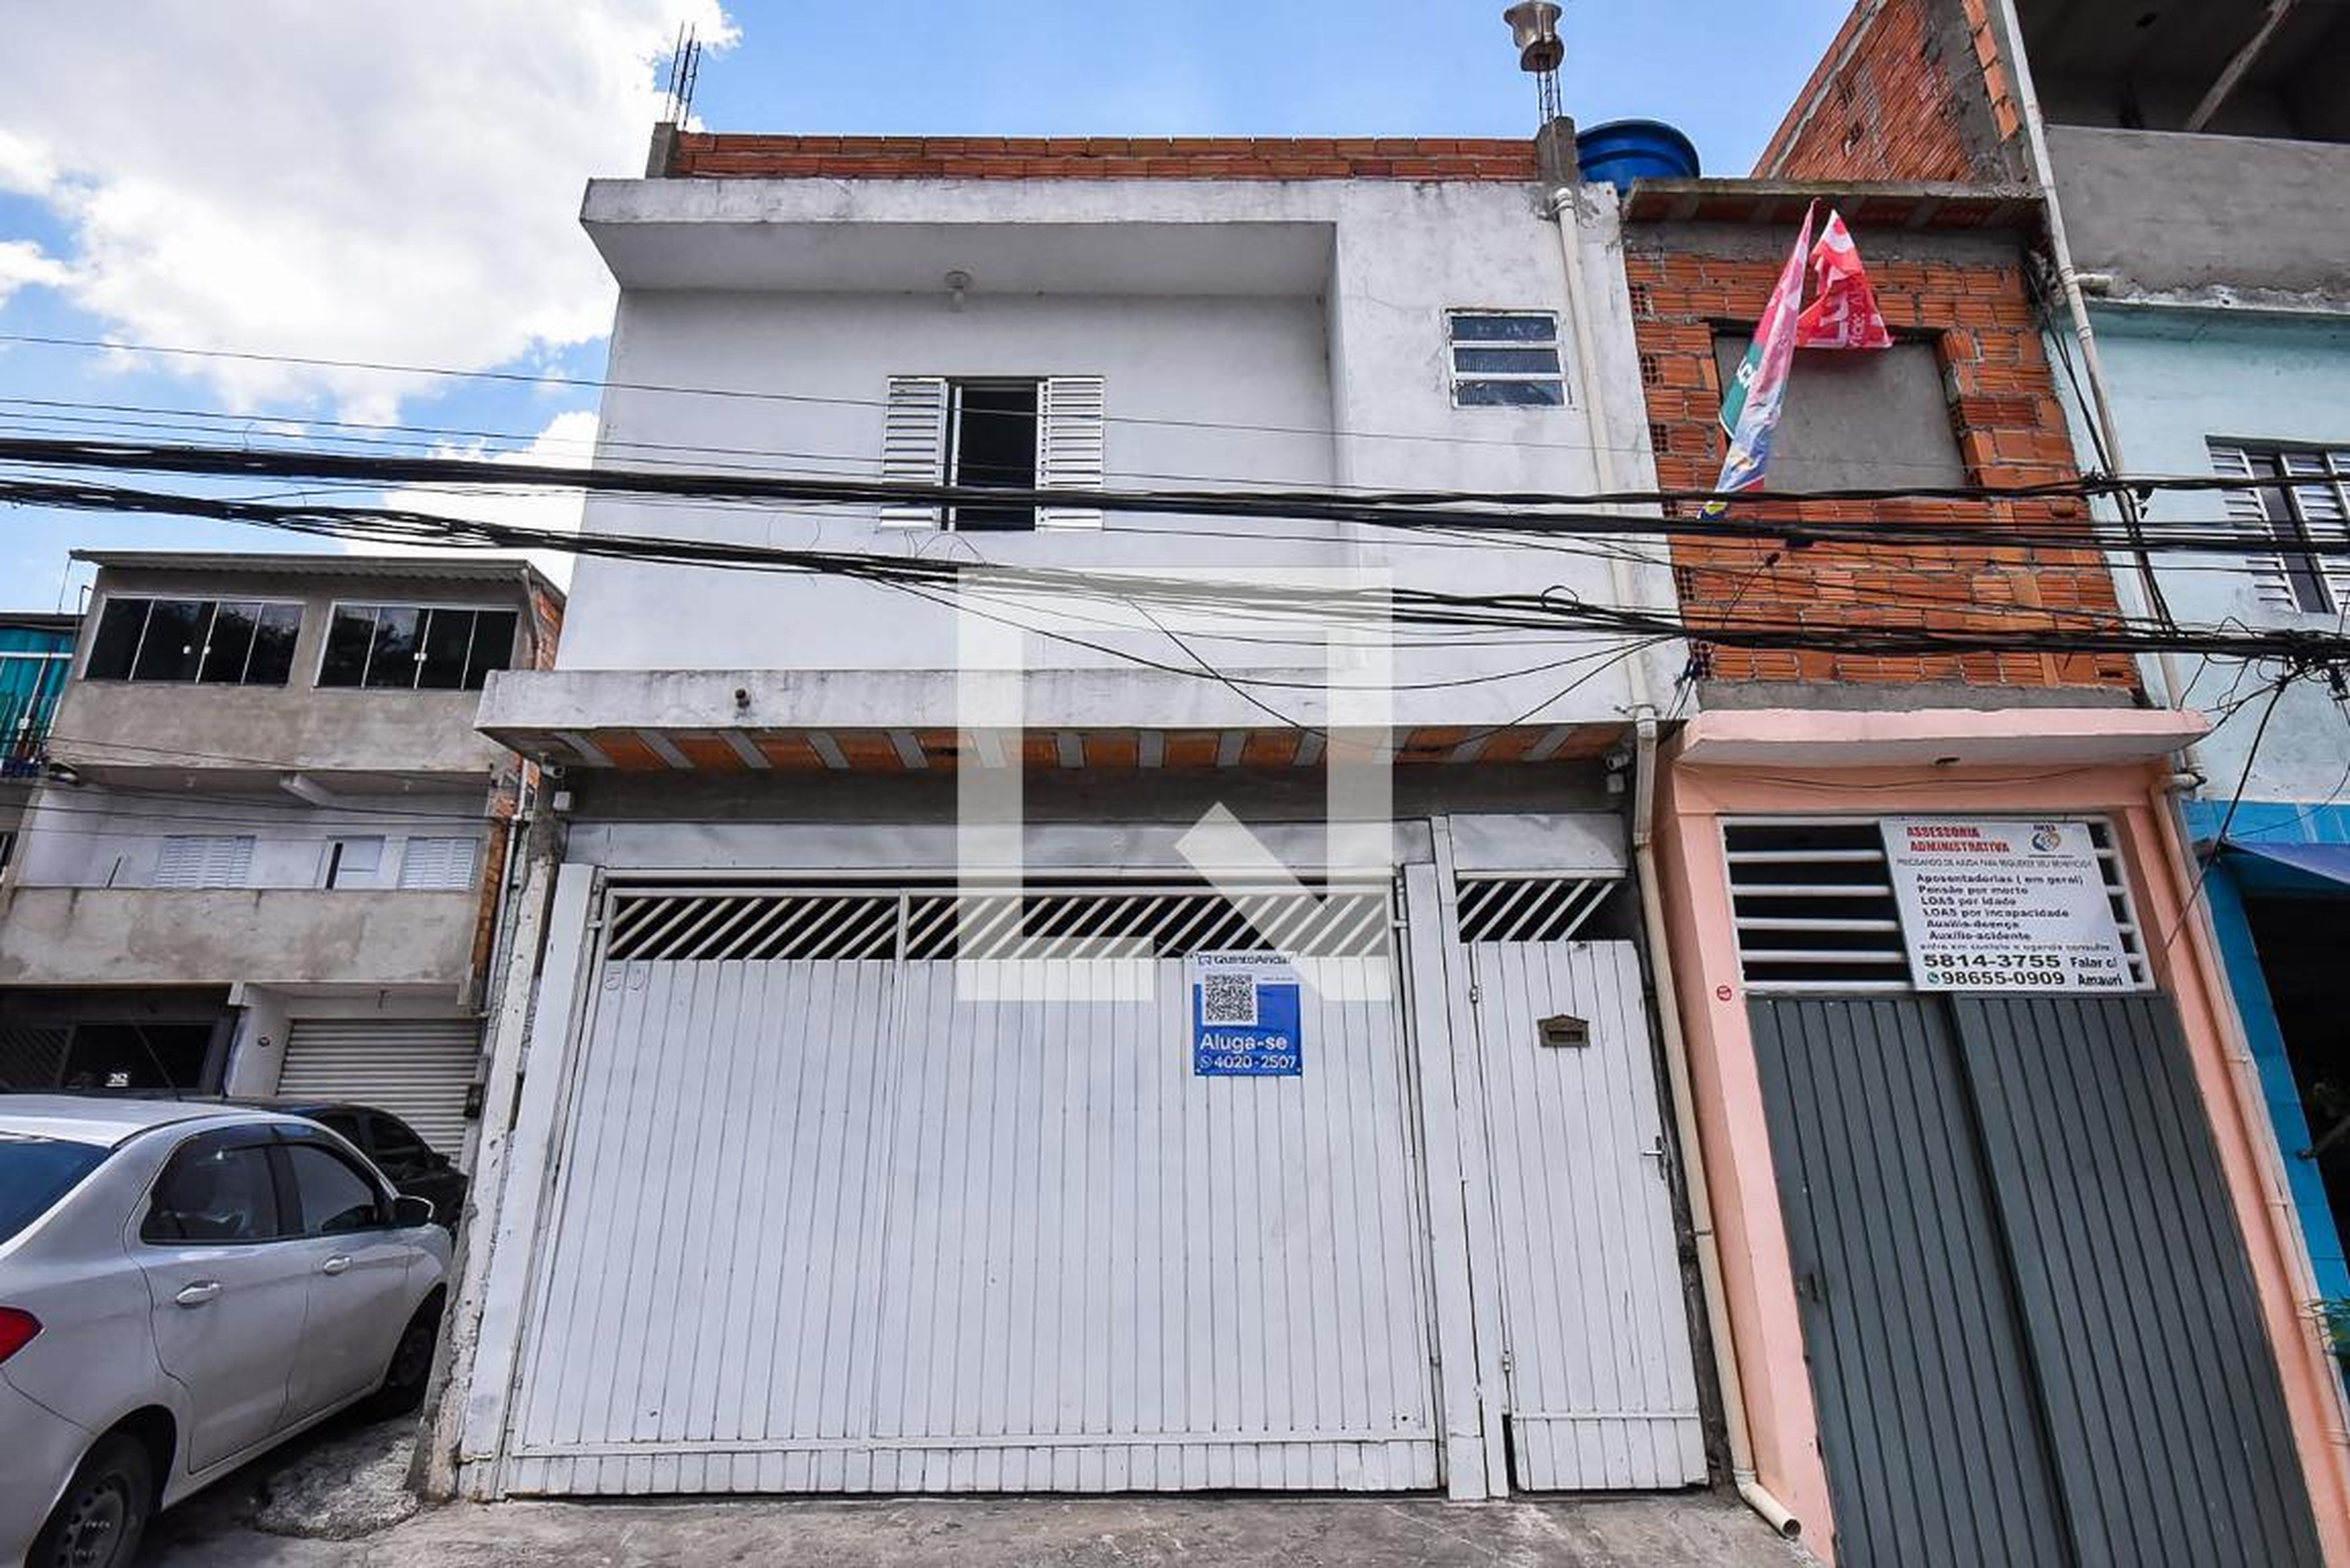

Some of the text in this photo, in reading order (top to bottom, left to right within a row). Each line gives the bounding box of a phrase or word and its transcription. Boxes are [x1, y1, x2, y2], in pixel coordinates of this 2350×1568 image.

[1958, 897, 1978, 906] por
[1961, 909, 1981, 918] por
[1924, 954, 2061, 968] 5814-3755
[2070, 957, 2102, 968] Falar
[1941, 971, 2122, 986] 98655-0909 Amauri
[1199, 1033, 1288, 1054] Aluga-se
